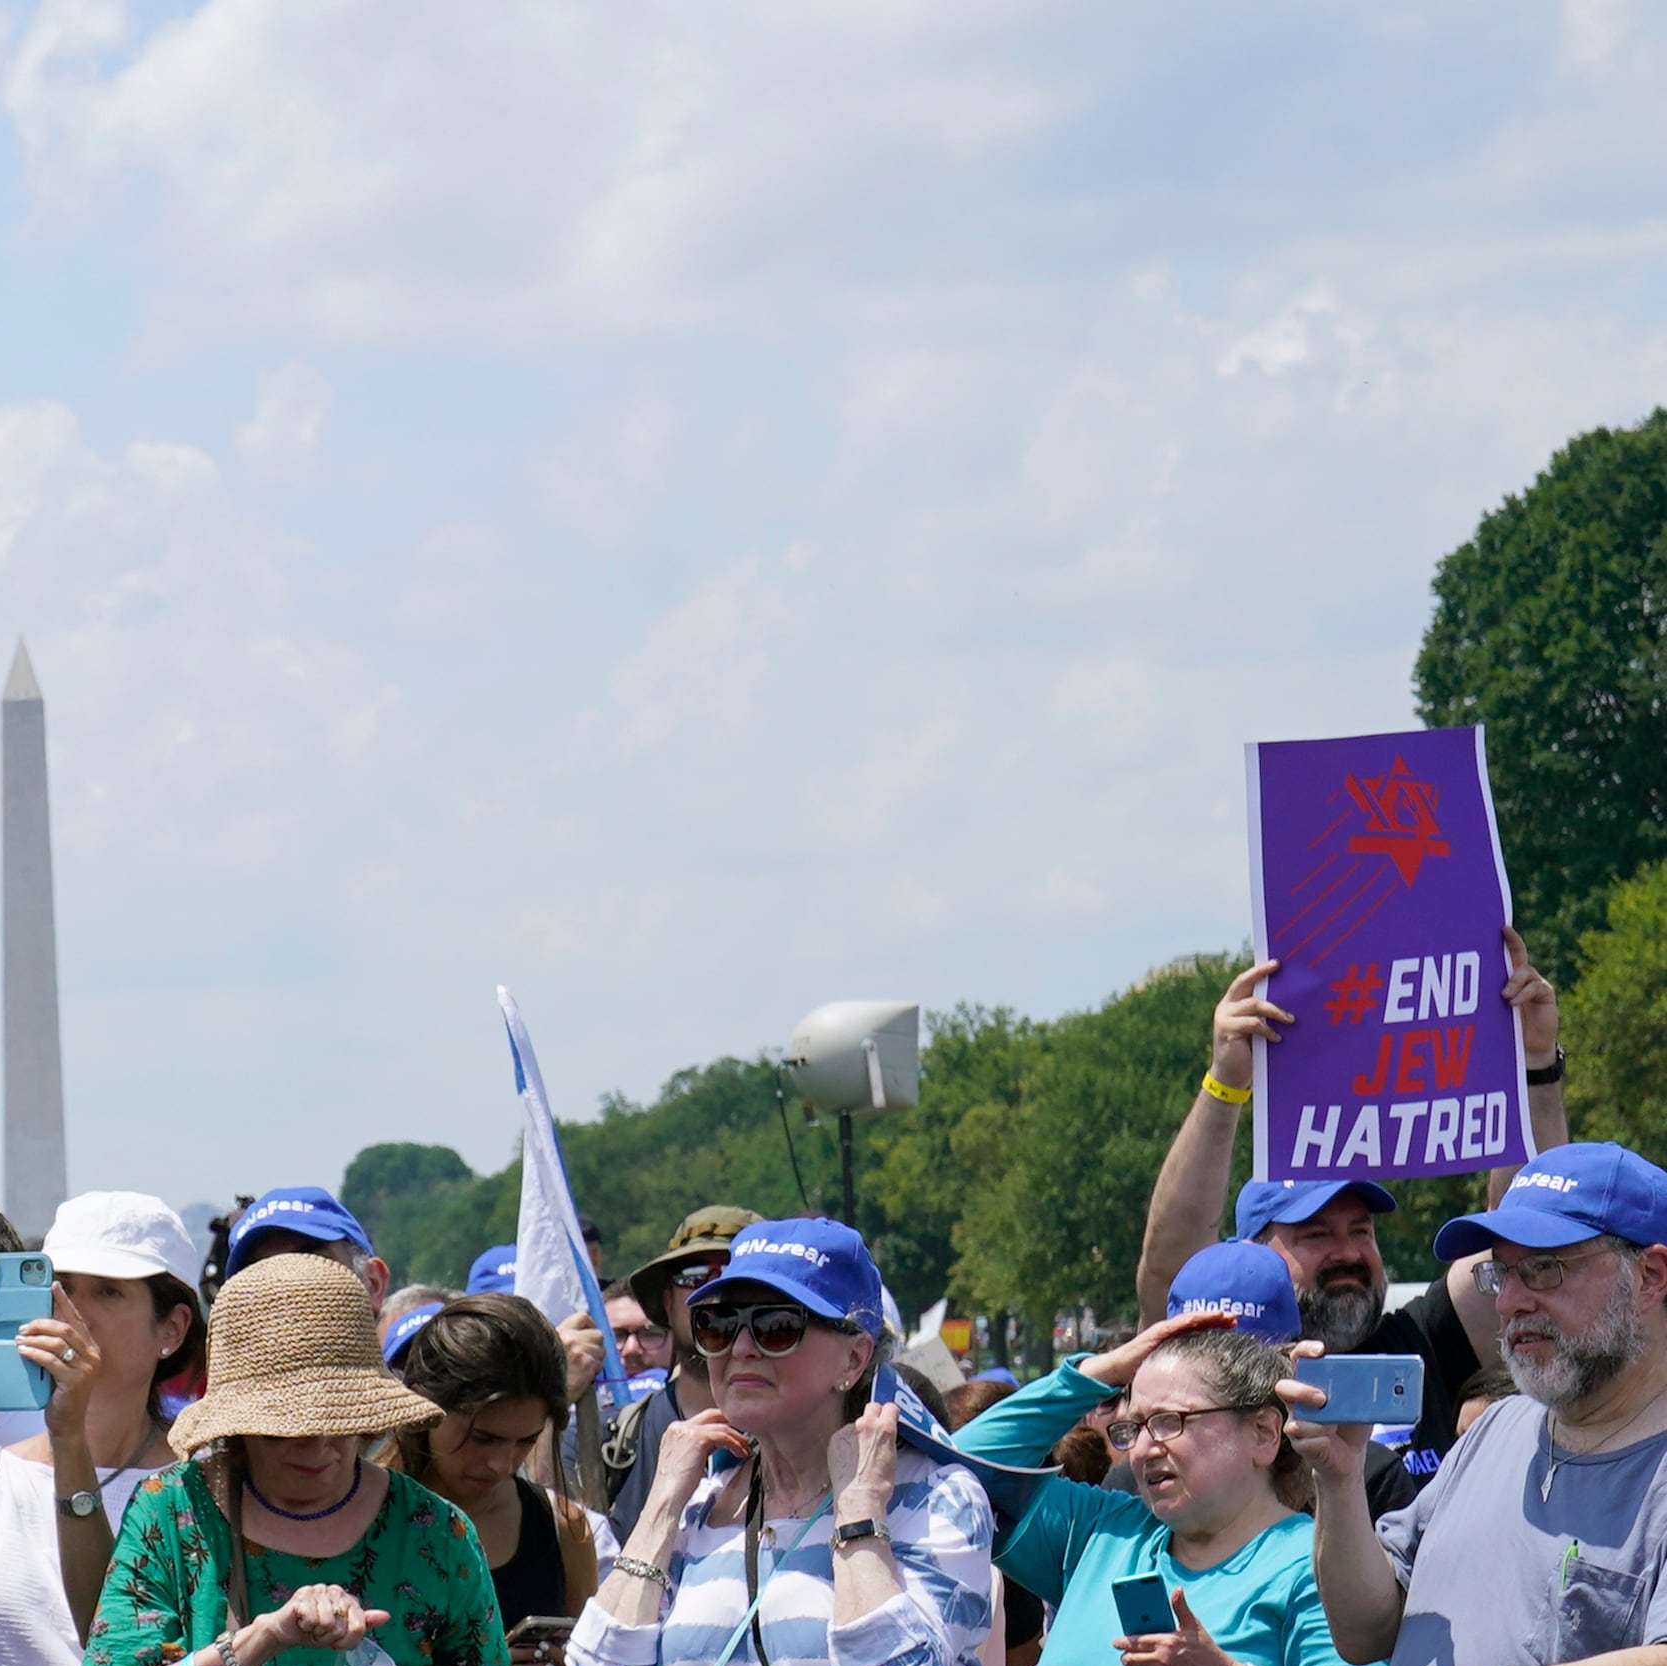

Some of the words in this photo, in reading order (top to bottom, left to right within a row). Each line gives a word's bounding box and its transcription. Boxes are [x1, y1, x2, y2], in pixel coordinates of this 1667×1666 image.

[1324, 951, 1480, 1025] #END
[1352, 1024, 1476, 1096] JEW
[1290, 1091, 1508, 1168] HATRED
[735, 1239, 830, 1268] #NoFear
